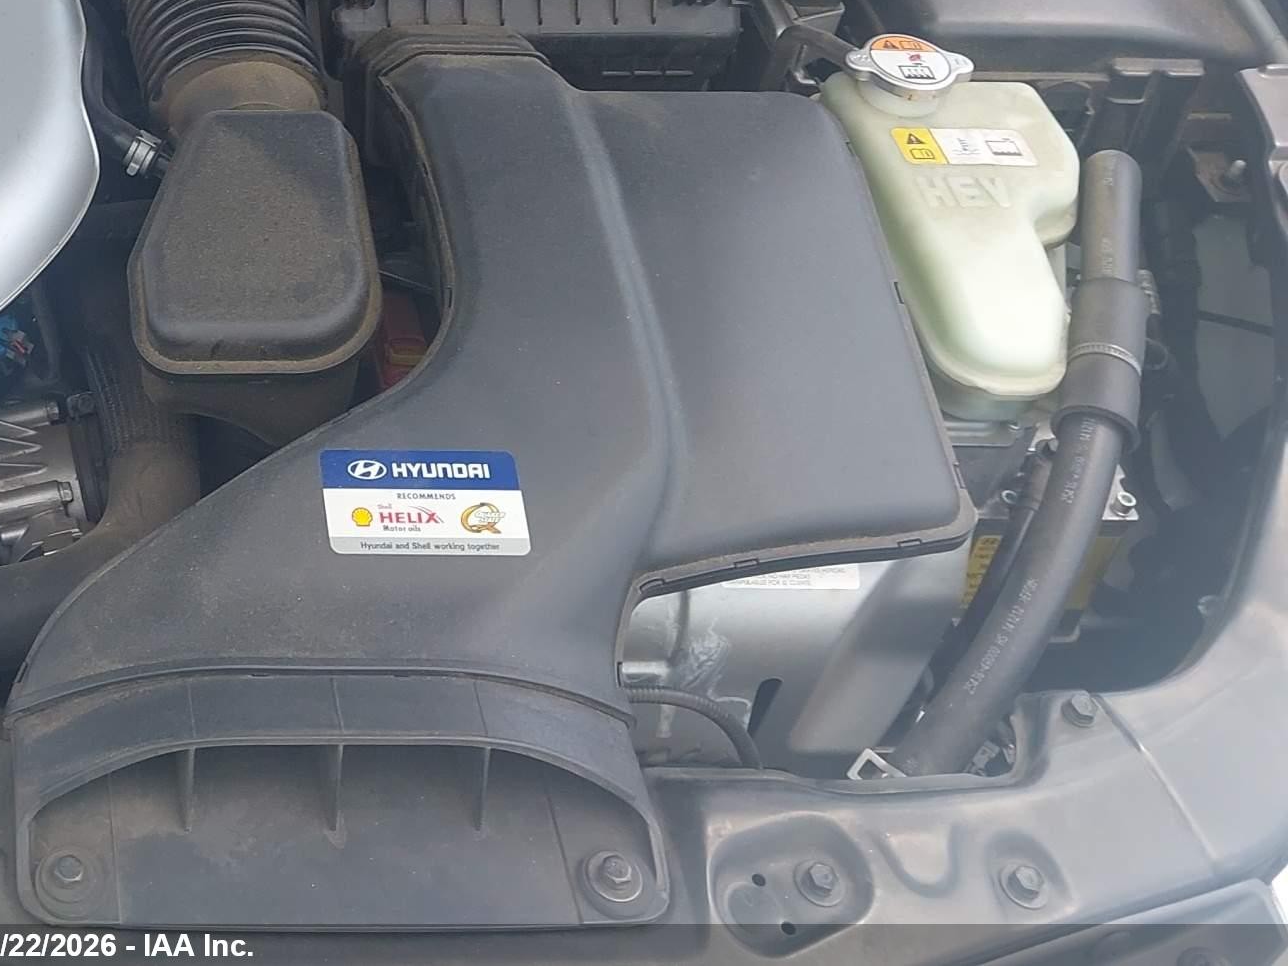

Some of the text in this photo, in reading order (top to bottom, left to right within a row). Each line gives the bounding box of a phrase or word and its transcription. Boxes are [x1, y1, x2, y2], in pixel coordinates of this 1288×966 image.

[916, 176, 1012, 208] HEV
[391, 462, 491, 479] HYUNDAI
[379, 511, 441, 524] HELIX
[360, 541, 500, 551] Hyundai and Shell working together
